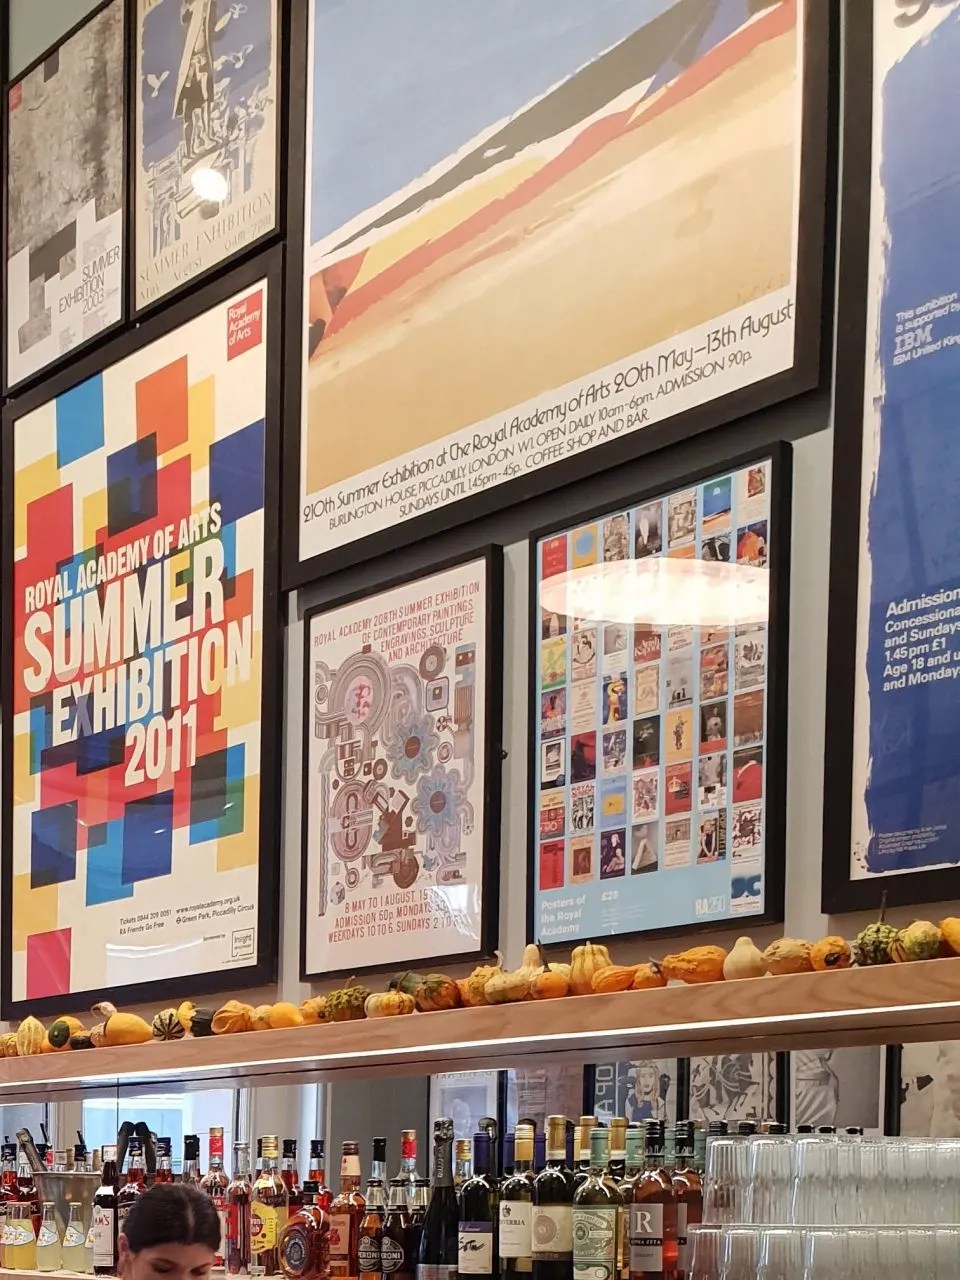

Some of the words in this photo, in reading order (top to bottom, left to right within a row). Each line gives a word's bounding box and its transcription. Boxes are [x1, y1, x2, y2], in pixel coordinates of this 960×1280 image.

[140, 241, 189, 282] SUMMER
[196, 190, 272, 252] EXHIBITION
[82, 245, 120, 283] SUMMER
[59, 271, 105, 314] EXHIBITION
[82, 287, 105, 315] 2003
[228, 301, 247, 321] Royal
[228, 308, 261, 334] Academy
[896, 309, 914, 322] This
[904, 304, 950, 330] supported
[236, 328, 252, 343] Arts
[894, 323, 933, 355] IBM
[893, 352, 911, 366] IBM
[912, 340, 943, 359] United
[303, 498, 336, 524] 210th
[336, 477, 381, 510] Summer
[382, 458, 435, 489] Exhibition
[436, 447, 448, 467] at
[449, 440, 471, 462] The
[471, 421, 508, 453] Royal
[508, 404, 567, 438] Academy
[567, 387, 585, 413] of
[585, 379, 611, 403] Arts
[613, 356, 654, 395] 20th
[740, 298, 794, 341] August
[329, 498, 384, 530] BURLINGTON
[384, 485, 418, 508] HOUSE
[418, 463, 468, 497] PICCADILLY
[468, 443, 515, 474] LONDON
[536, 421, 566, 443] OPEN
[568, 409, 597, 435] DAILY
[656, 356, 726, 399] ADMISSION
[399, 491, 441, 518] SUNDAYS
[440, 478, 467, 502] UNTIL
[525, 443, 565, 469] COFFEE
[566, 430, 597, 453] SHOP
[598, 417, 624, 441] AND
[25, 571, 73, 614] ROYAL
[76, 538, 149, 594] ACADEMY
[152, 523, 175, 561] OF
[177, 502, 223, 550] ARTS
[314, 629, 337, 647] ROYAL
[338, 617, 373, 638] ACADEMY
[398, 596, 433, 618] SUMMER
[435, 581, 480, 606] EXHIBITION
[886, 587, 960, 618] Admission
[23, 538, 226, 694] SUMMER
[361, 632, 371, 644] OF
[373, 614, 431, 642] CONTEMPORARY
[429, 611, 475, 637] SCULPTURE
[388, 648, 403, 662] AND
[405, 628, 464, 658] ARCHITECTURE
[884, 631, 908, 648] and
[932, 637, 946, 651] £1
[883, 663, 908, 678] Age
[910, 657, 925, 670] 18
[926, 650, 951, 667] and
[52, 616, 254, 748] EXHIBITION
[883, 675, 906, 692] and
[124, 703, 198, 788] 2011
[182, 916, 198, 924] Green
[198, 911, 211, 921] Park,
[212, 906, 237, 917] Piccadilly
[237, 904, 255, 913] Circus
[334, 911, 376, 929] ADMISSION
[378, 909, 394, 922] 60p
[396, 900, 433, 918] MONDAYS
[345, 902, 350, 914] 8
[352, 899, 366, 912] MAY
[368, 897, 378, 909] TO
[541, 898, 574, 911] Posters
[576, 894, 587, 905] of
[695, 895, 726, 916] RA250
[120, 916, 137, 926] Tickets
[127, 925, 145, 934] Friends
[145, 923, 153, 931] Go
[153, 921, 165, 929] Free
[541, 911, 556, 924] the
[557, 908, 582, 924] Royal
[234, 934, 252, 945] Insight
[328, 927, 365, 943] WEEKDAYS
[368, 925, 376, 936] 10
[377, 924, 386, 936] TO
[396, 918, 431, 933] SUNDAYS
[433, 917, 438, 929] 2
[541, 922, 581, 937] Academy
[635, 1211, 653, 1233] R
